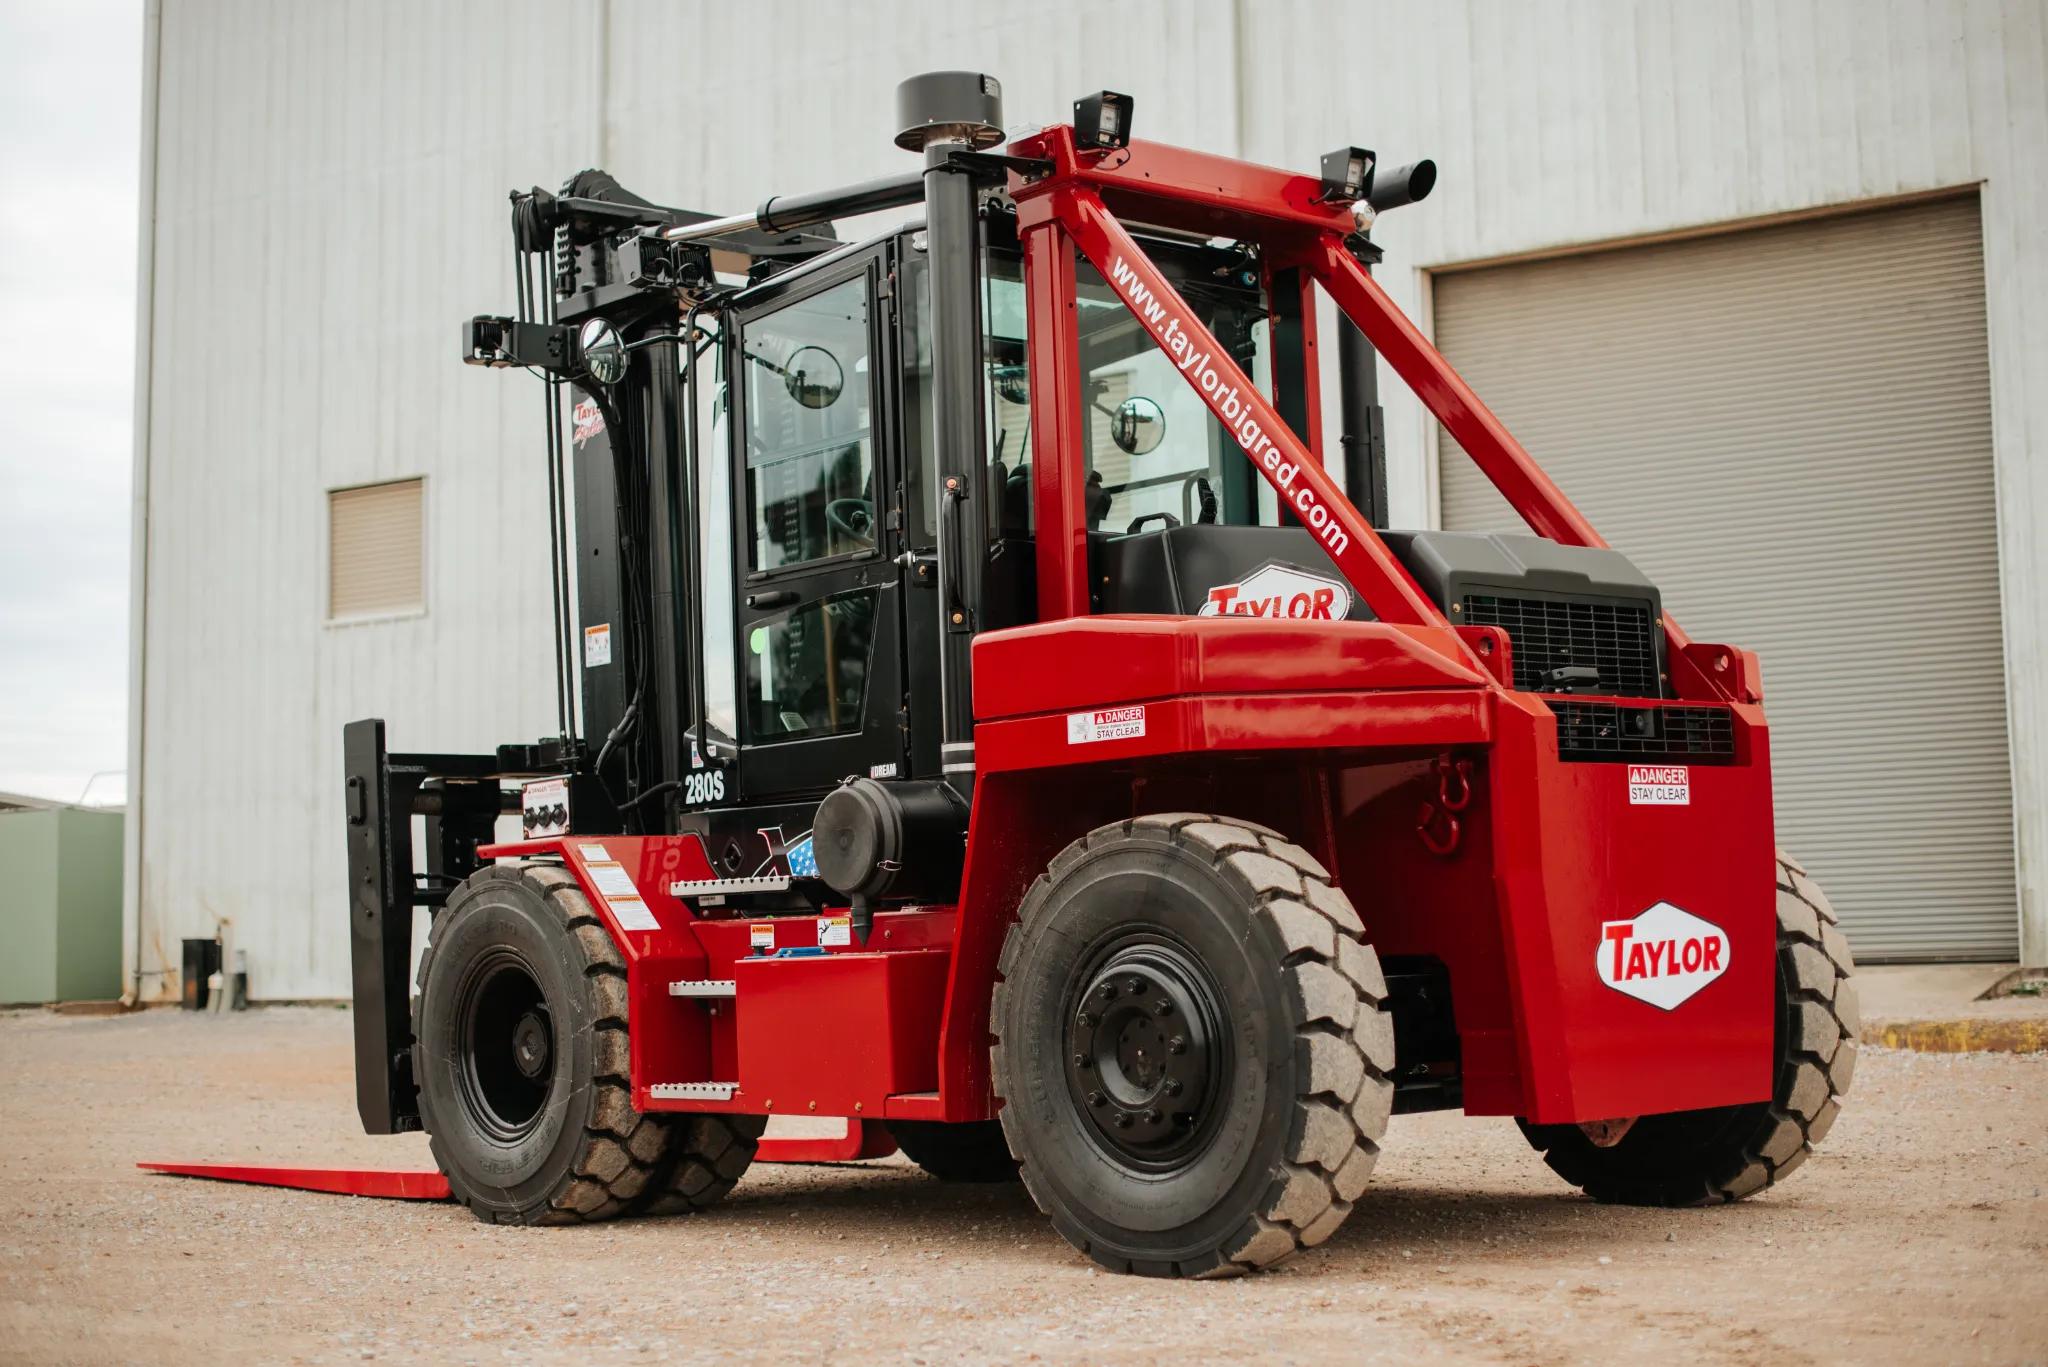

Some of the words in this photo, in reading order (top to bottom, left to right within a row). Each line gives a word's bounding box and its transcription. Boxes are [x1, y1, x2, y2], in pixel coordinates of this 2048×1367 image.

[1112, 256, 1349, 557] www.taylorbigred.com
[1105, 709, 1142, 722] DANGER
[1097, 729, 1113, 738] STAY
[1116, 727, 1140, 736] CLEAR
[1640, 769, 1686, 783] DANGER
[685, 770, 724, 804] 280S
[1632, 788, 1653, 800] STAY
[1656, 788, 1686, 800] CLEAR
[1605, 924, 1721, 982] TAYLOR
